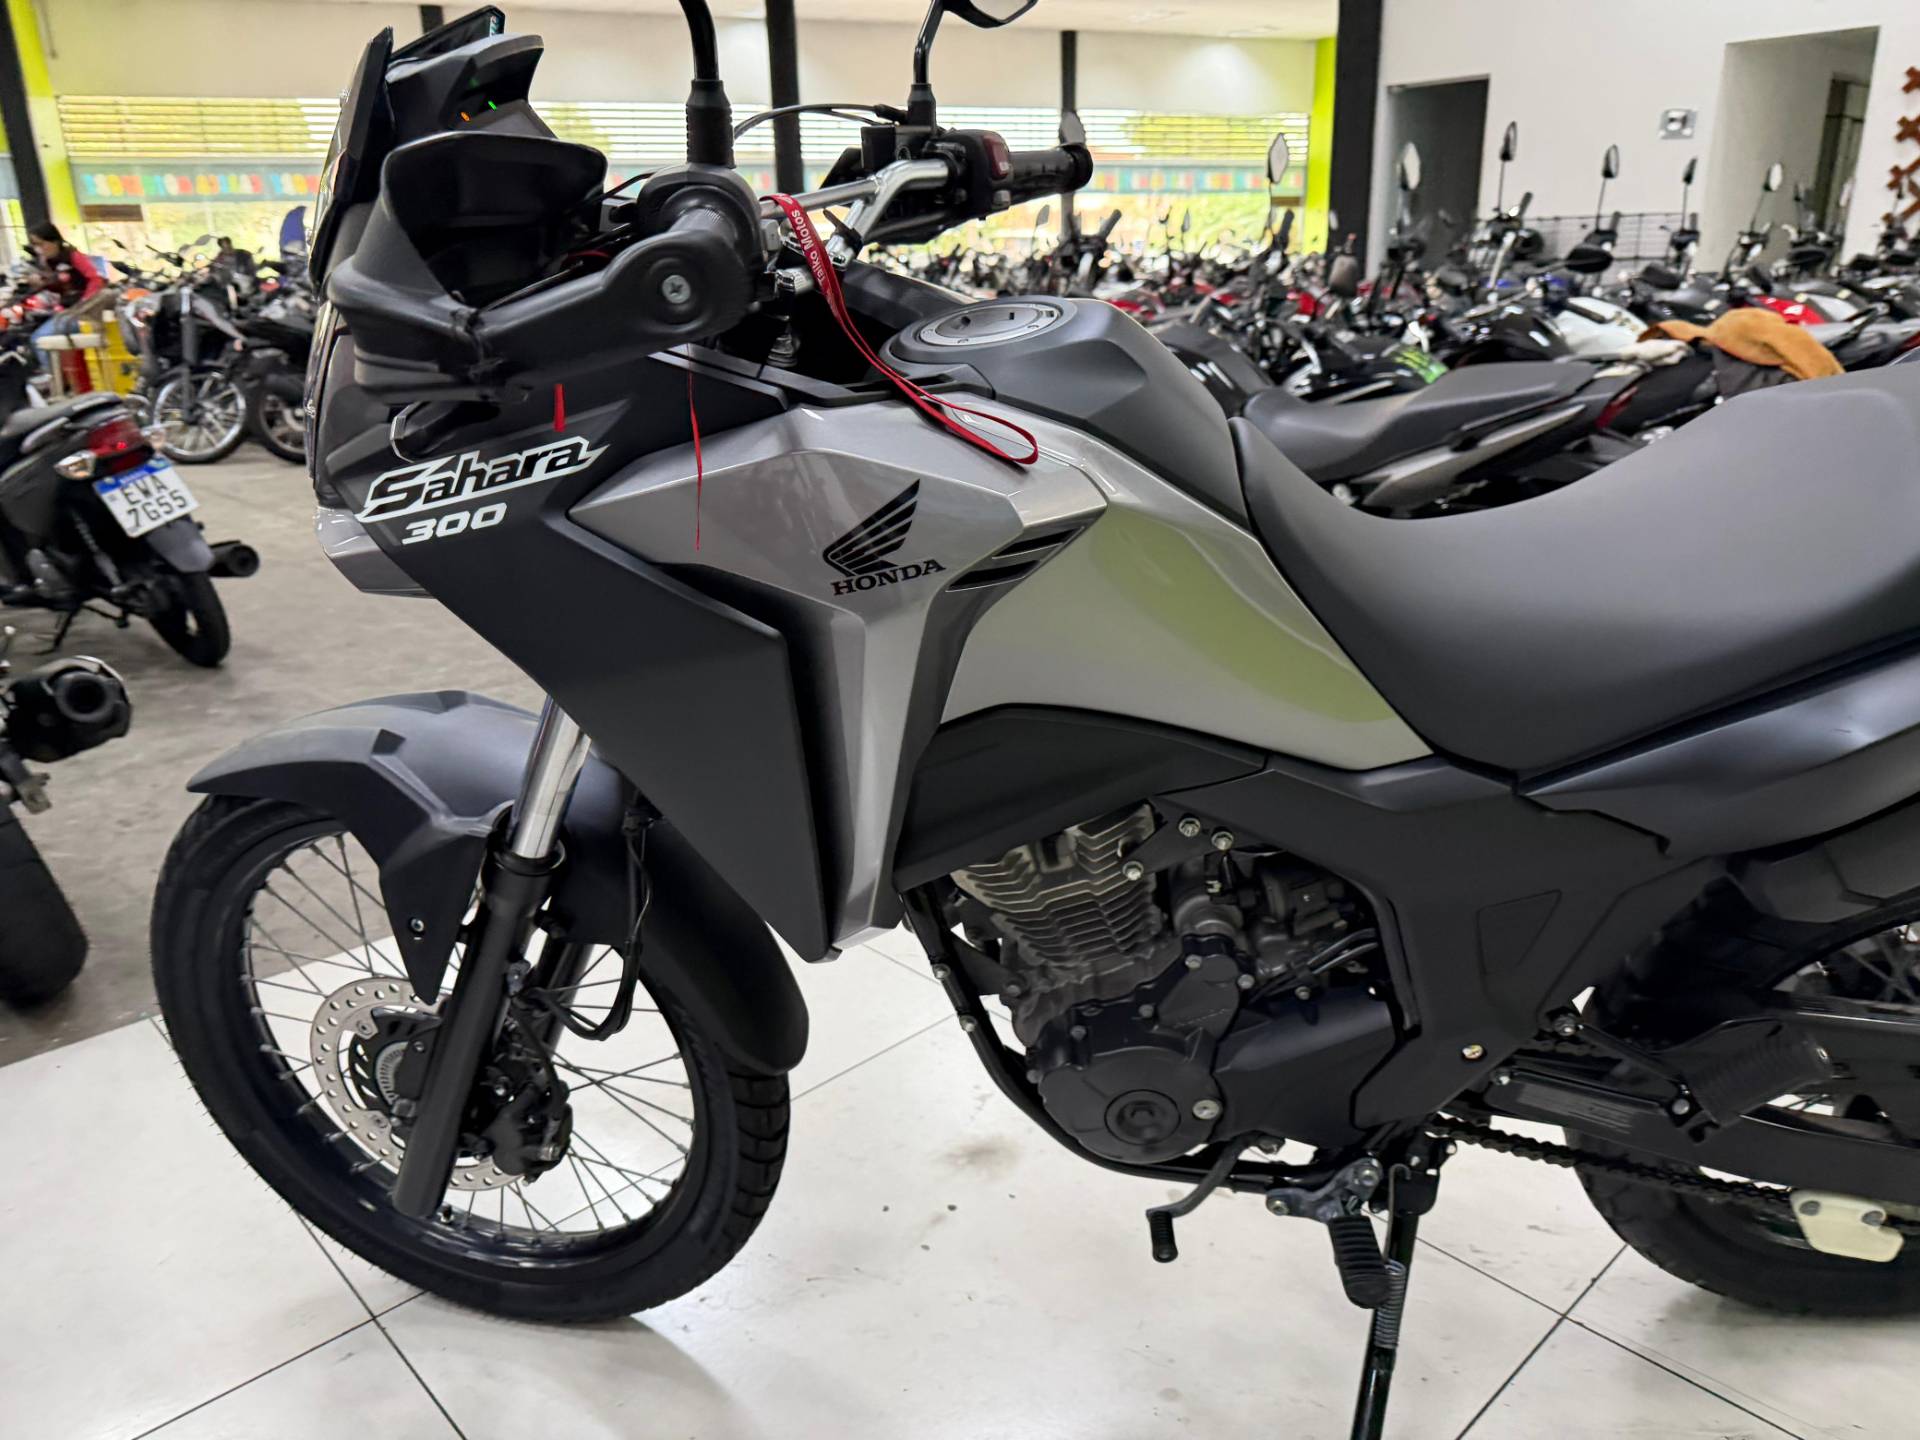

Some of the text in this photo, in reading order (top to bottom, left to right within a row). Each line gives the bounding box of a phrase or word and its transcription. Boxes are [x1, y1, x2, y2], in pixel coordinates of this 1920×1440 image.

[791, 209, 814, 250] Motos
[354, 435, 609, 522] Sahara
[127, 490, 187, 527] 7655
[402, 502, 507, 545] 300
[831, 559, 946, 596] HONDA
